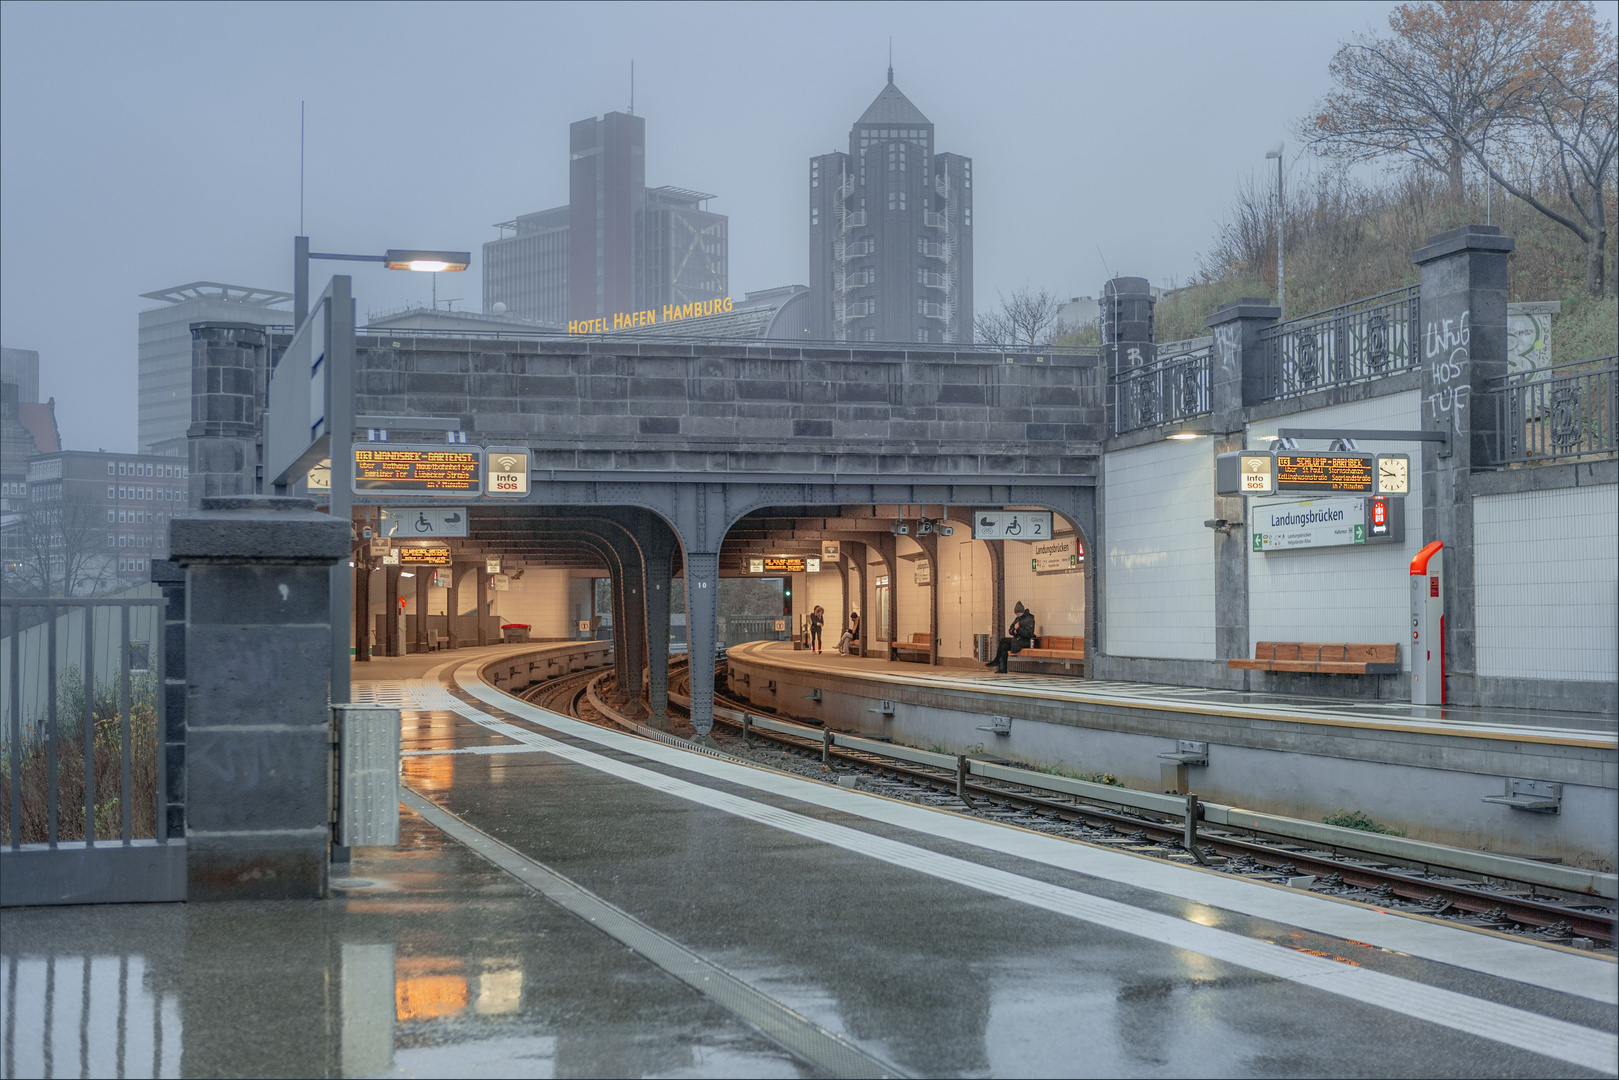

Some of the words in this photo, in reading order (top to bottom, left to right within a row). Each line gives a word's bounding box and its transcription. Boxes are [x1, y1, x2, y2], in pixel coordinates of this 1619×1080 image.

[568, 317, 609, 337] HOTEL
[613, 309, 657, 330] HAFEN
[663, 296, 734, 323] HAMBURG
[496, 474, 517, 482] Info
[497, 482, 517, 490] SOS
[1271, 507, 1344, 529] Landungsbrücken
[1034, 523, 1041, 535] 2
[1035, 542, 1069, 556] Landungsbrücken
